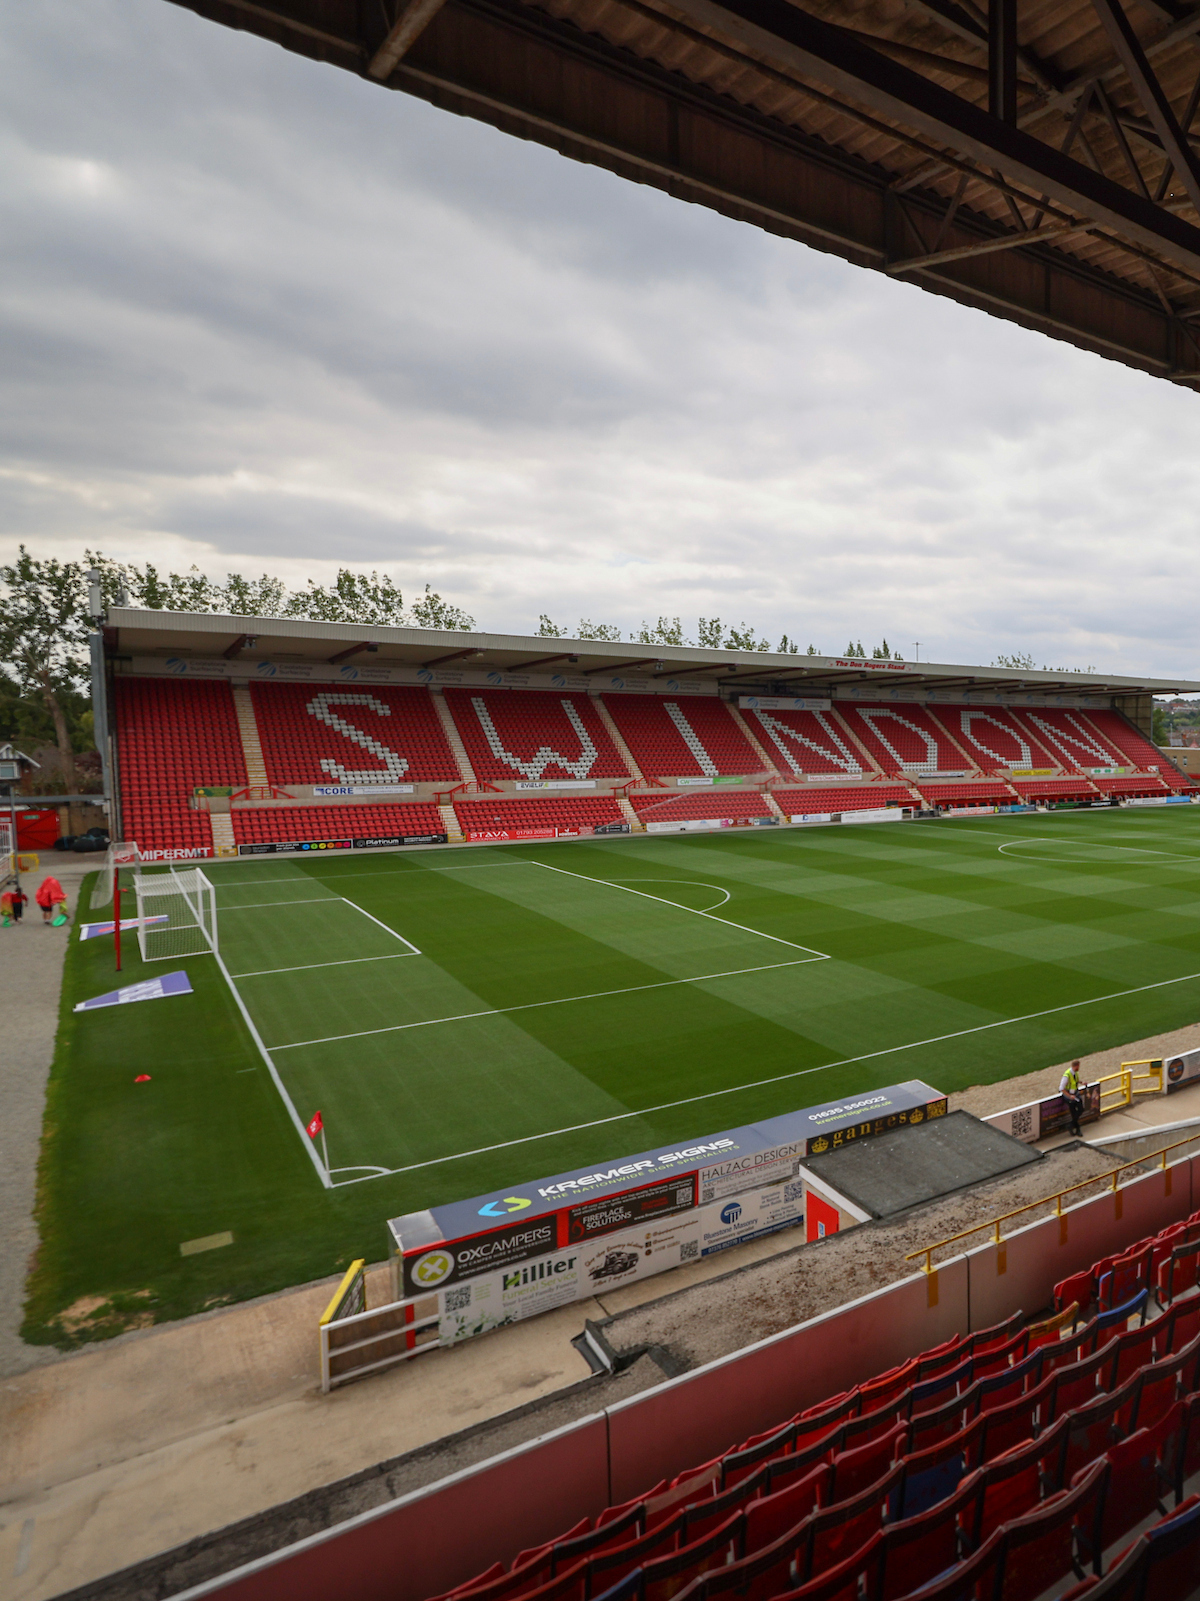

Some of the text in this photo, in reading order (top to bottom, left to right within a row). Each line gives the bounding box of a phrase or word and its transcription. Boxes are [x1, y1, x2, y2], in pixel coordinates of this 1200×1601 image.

[325, 787, 354, 795] CORE
[470, 831, 509, 839] STAVA
[808, 1094, 887, 1121] 01635 550022
[815, 1099, 892, 1126] kremersigns.co.uk
[832, 1111, 906, 1148] ganges
[537, 1136, 734, 1198] KREMER SIGNS
[545, 1144, 739, 1202] THE NATIONWIDE SIGN SPECIALISTS
[701, 1143, 798, 1181] HALZAC DESIGN
[702, 1169, 752, 1188] ARCHITECTURAL
[755, 1161, 777, 1173] DESIGN
[582, 1205, 624, 1224] FIREPLACE
[586, 1210, 631, 1230] SOLUTIONS
[703, 1225, 731, 1241] Bluestone
[733, 1217, 757, 1230] Masonry
[457, 1224, 552, 1263] OXCAMPERS
[468, 1254, 492, 1266] CAMPER
[493, 1250, 505, 1258] HIRE
[512, 1236, 551, 1252] CONVERSIONS
[458, 1251, 527, 1277] www.oxcampers.co.uk
[502, 1254, 576, 1291] Hillier
[502, 1282, 538, 1301] Funeral
[540, 1270, 577, 1288] Service
[518, 1292, 533, 1303] Local
[535, 1286, 553, 1297] Family
[556, 1278, 577, 1290] Funeral
